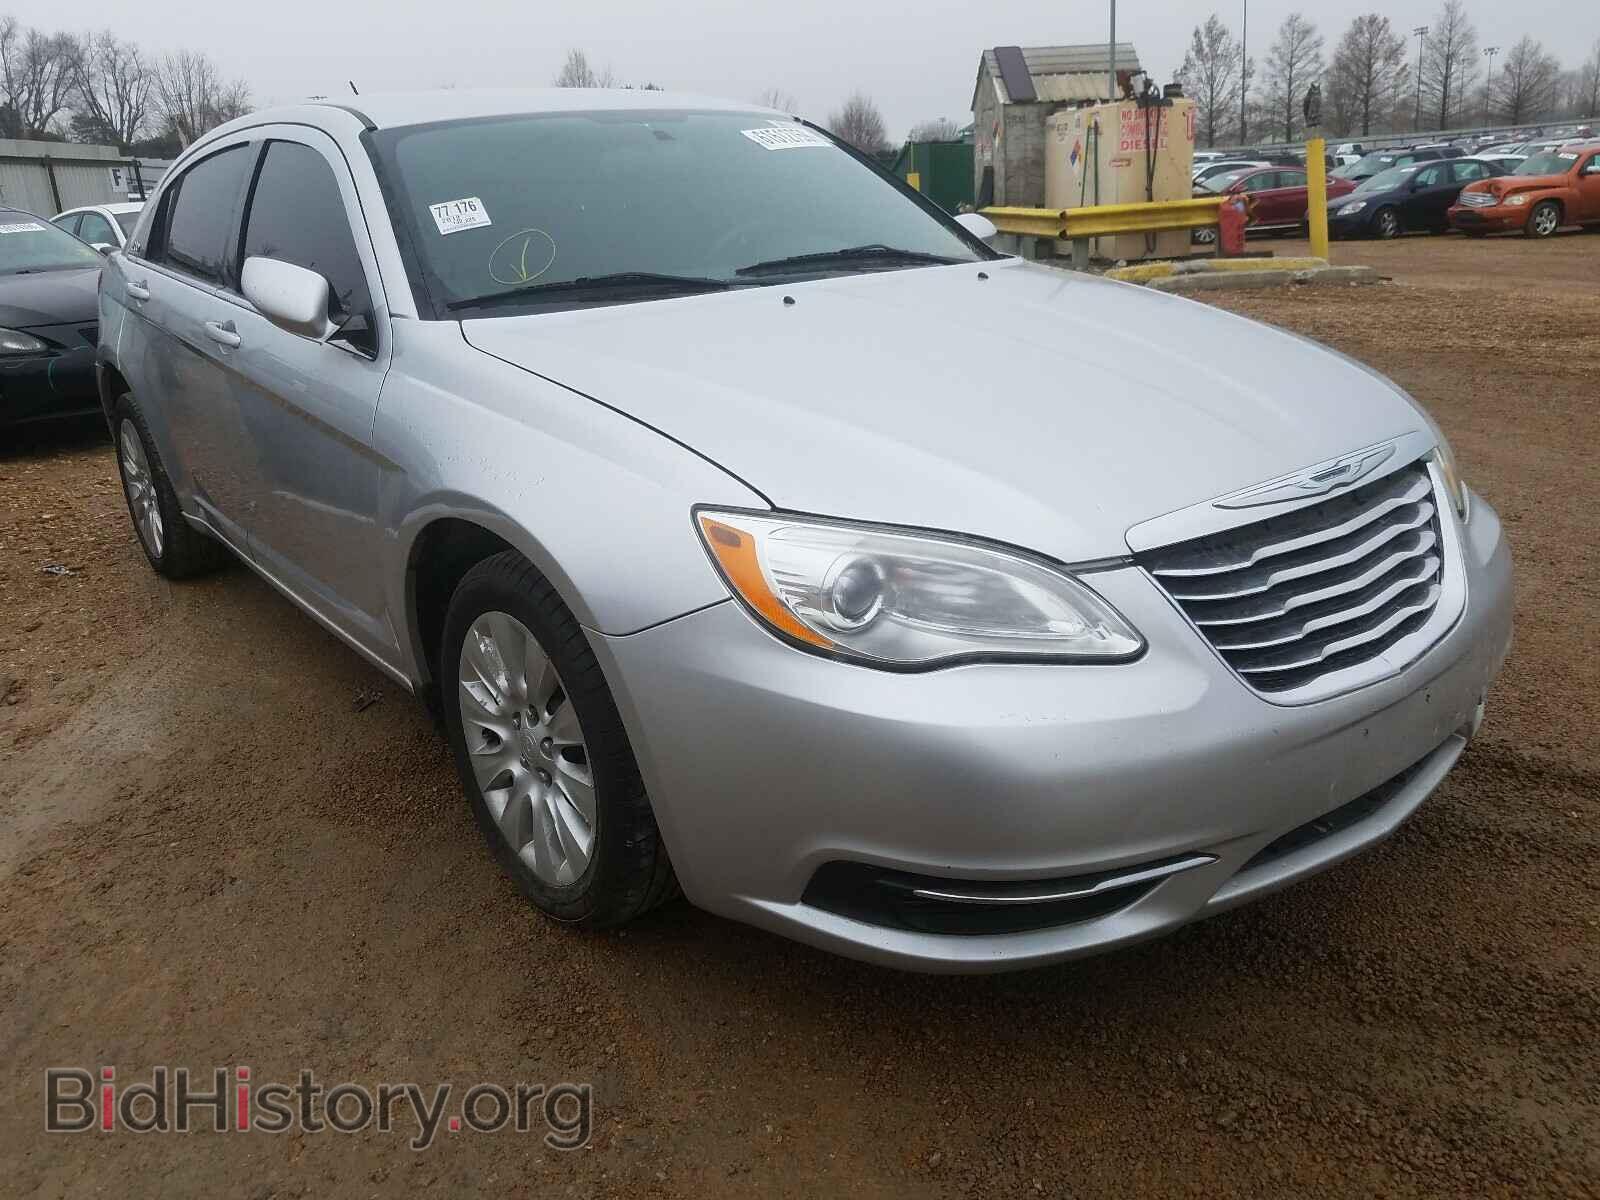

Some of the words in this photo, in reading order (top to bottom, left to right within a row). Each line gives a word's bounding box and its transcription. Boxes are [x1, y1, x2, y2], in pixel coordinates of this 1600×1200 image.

[1121, 109, 1131, 121] NO
[1134, 108, 1167, 121] SMKIG
[111, 168, 122, 187] F
[434, 205, 449, 218] 77
[454, 200, 477, 213] 176
